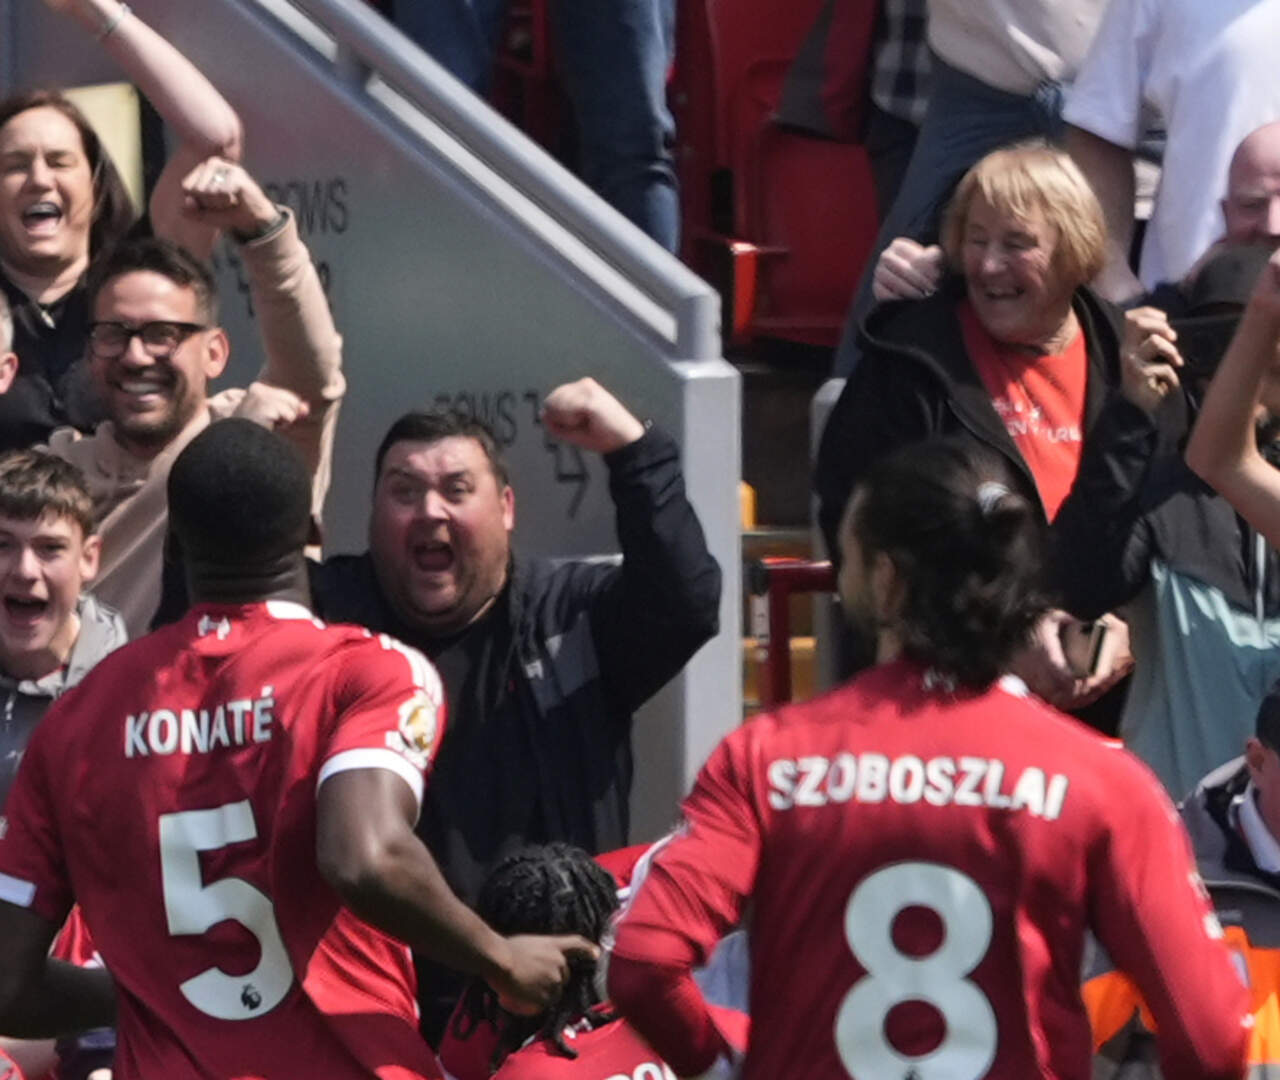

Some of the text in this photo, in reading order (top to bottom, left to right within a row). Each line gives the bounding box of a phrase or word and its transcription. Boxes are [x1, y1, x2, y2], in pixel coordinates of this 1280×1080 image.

[125, 687, 275, 758] KONATÉ
[767, 751, 1069, 821] SZOBOSZLAI
[158, 799, 295, 1020] 5
